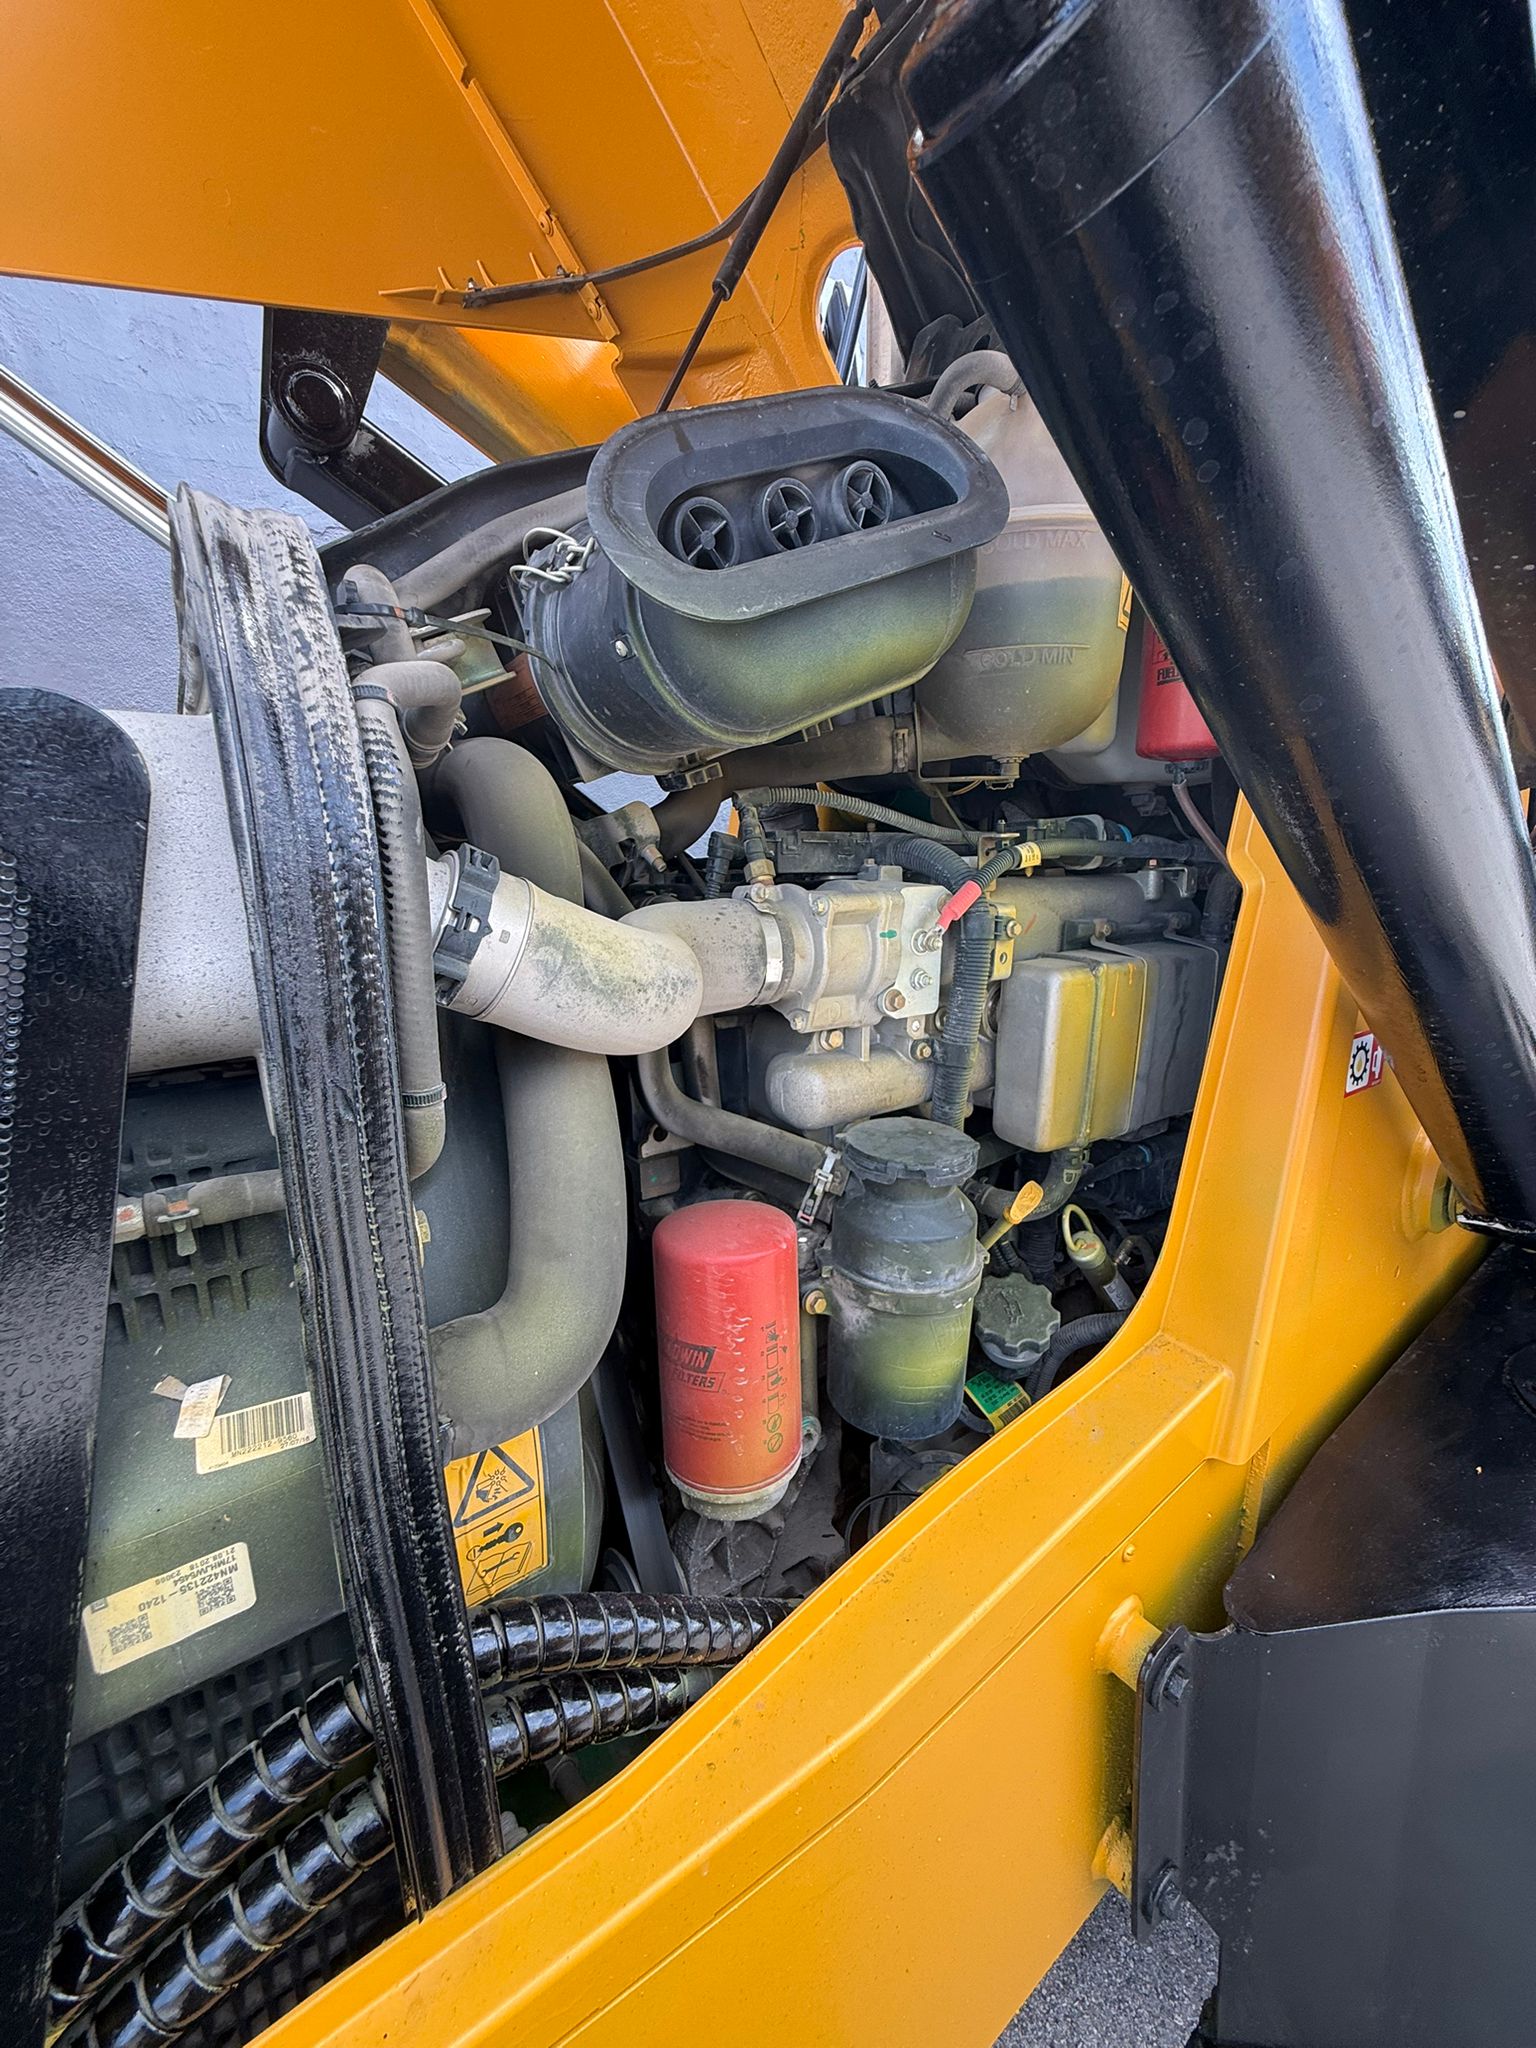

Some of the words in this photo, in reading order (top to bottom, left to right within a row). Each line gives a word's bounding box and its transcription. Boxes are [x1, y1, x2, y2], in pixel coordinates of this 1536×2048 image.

[1046, 530, 1088, 550] MAX
[1041, 647, 1076, 665] MIN
[672, 1367, 716, 1389] FILTERS
